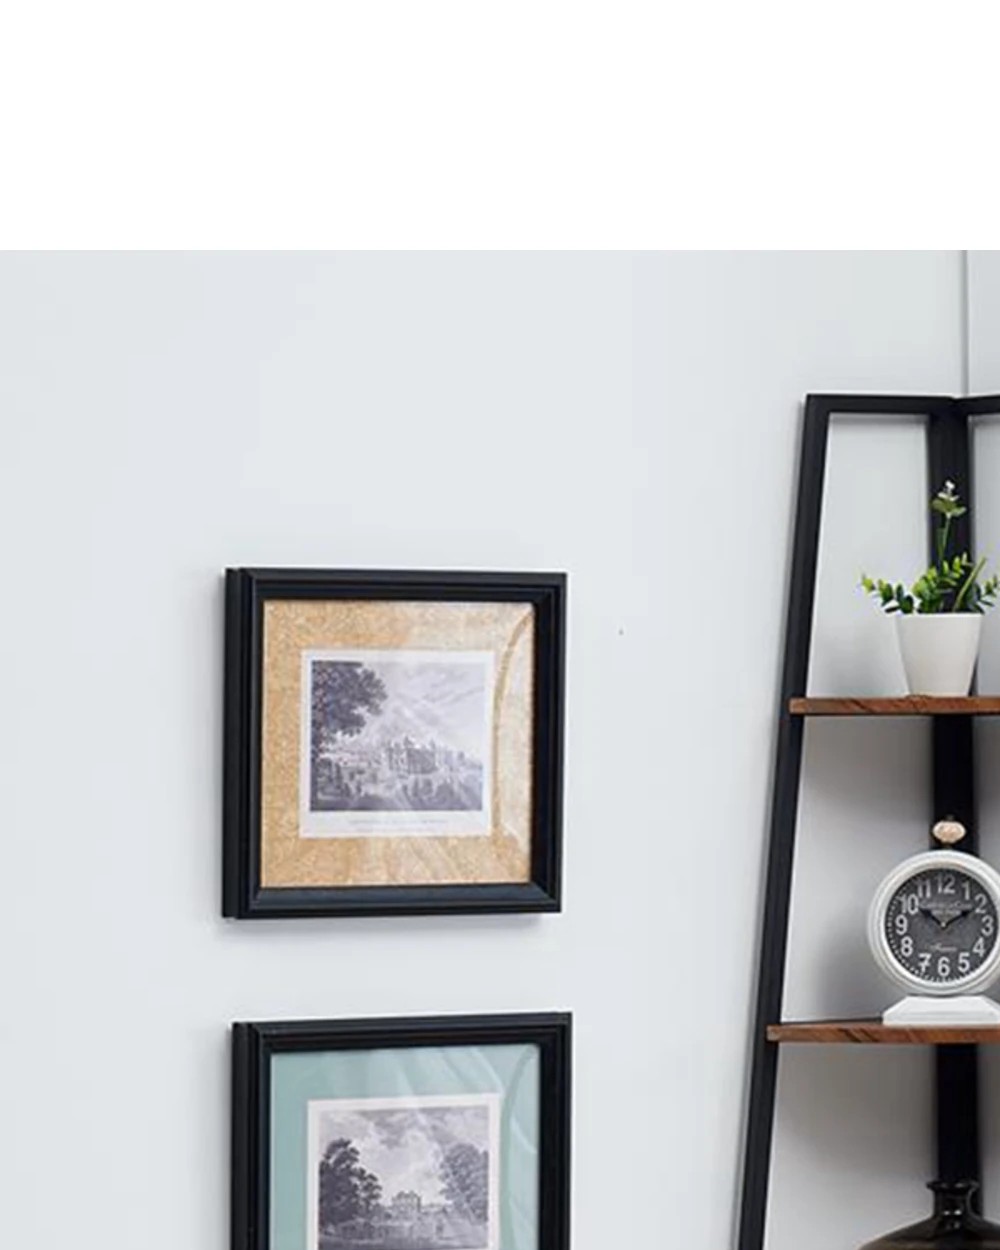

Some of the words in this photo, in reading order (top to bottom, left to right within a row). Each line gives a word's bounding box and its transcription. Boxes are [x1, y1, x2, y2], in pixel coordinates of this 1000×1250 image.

[917, 878, 931, 899] 11
[936, 874, 956, 894] 12
[962, 880, 971, 900] 1
[901, 894, 919, 915] 10
[975, 894, 987, 914] 2
[895, 914, 908, 935] 9
[981, 915, 994, 936] 3
[901, 936, 913, 957] 8
[973, 937, 986, 958] 4
[919, 953, 932, 973] 7
[937, 956, 950, 976] 6
[958, 952, 971, 973] 5
